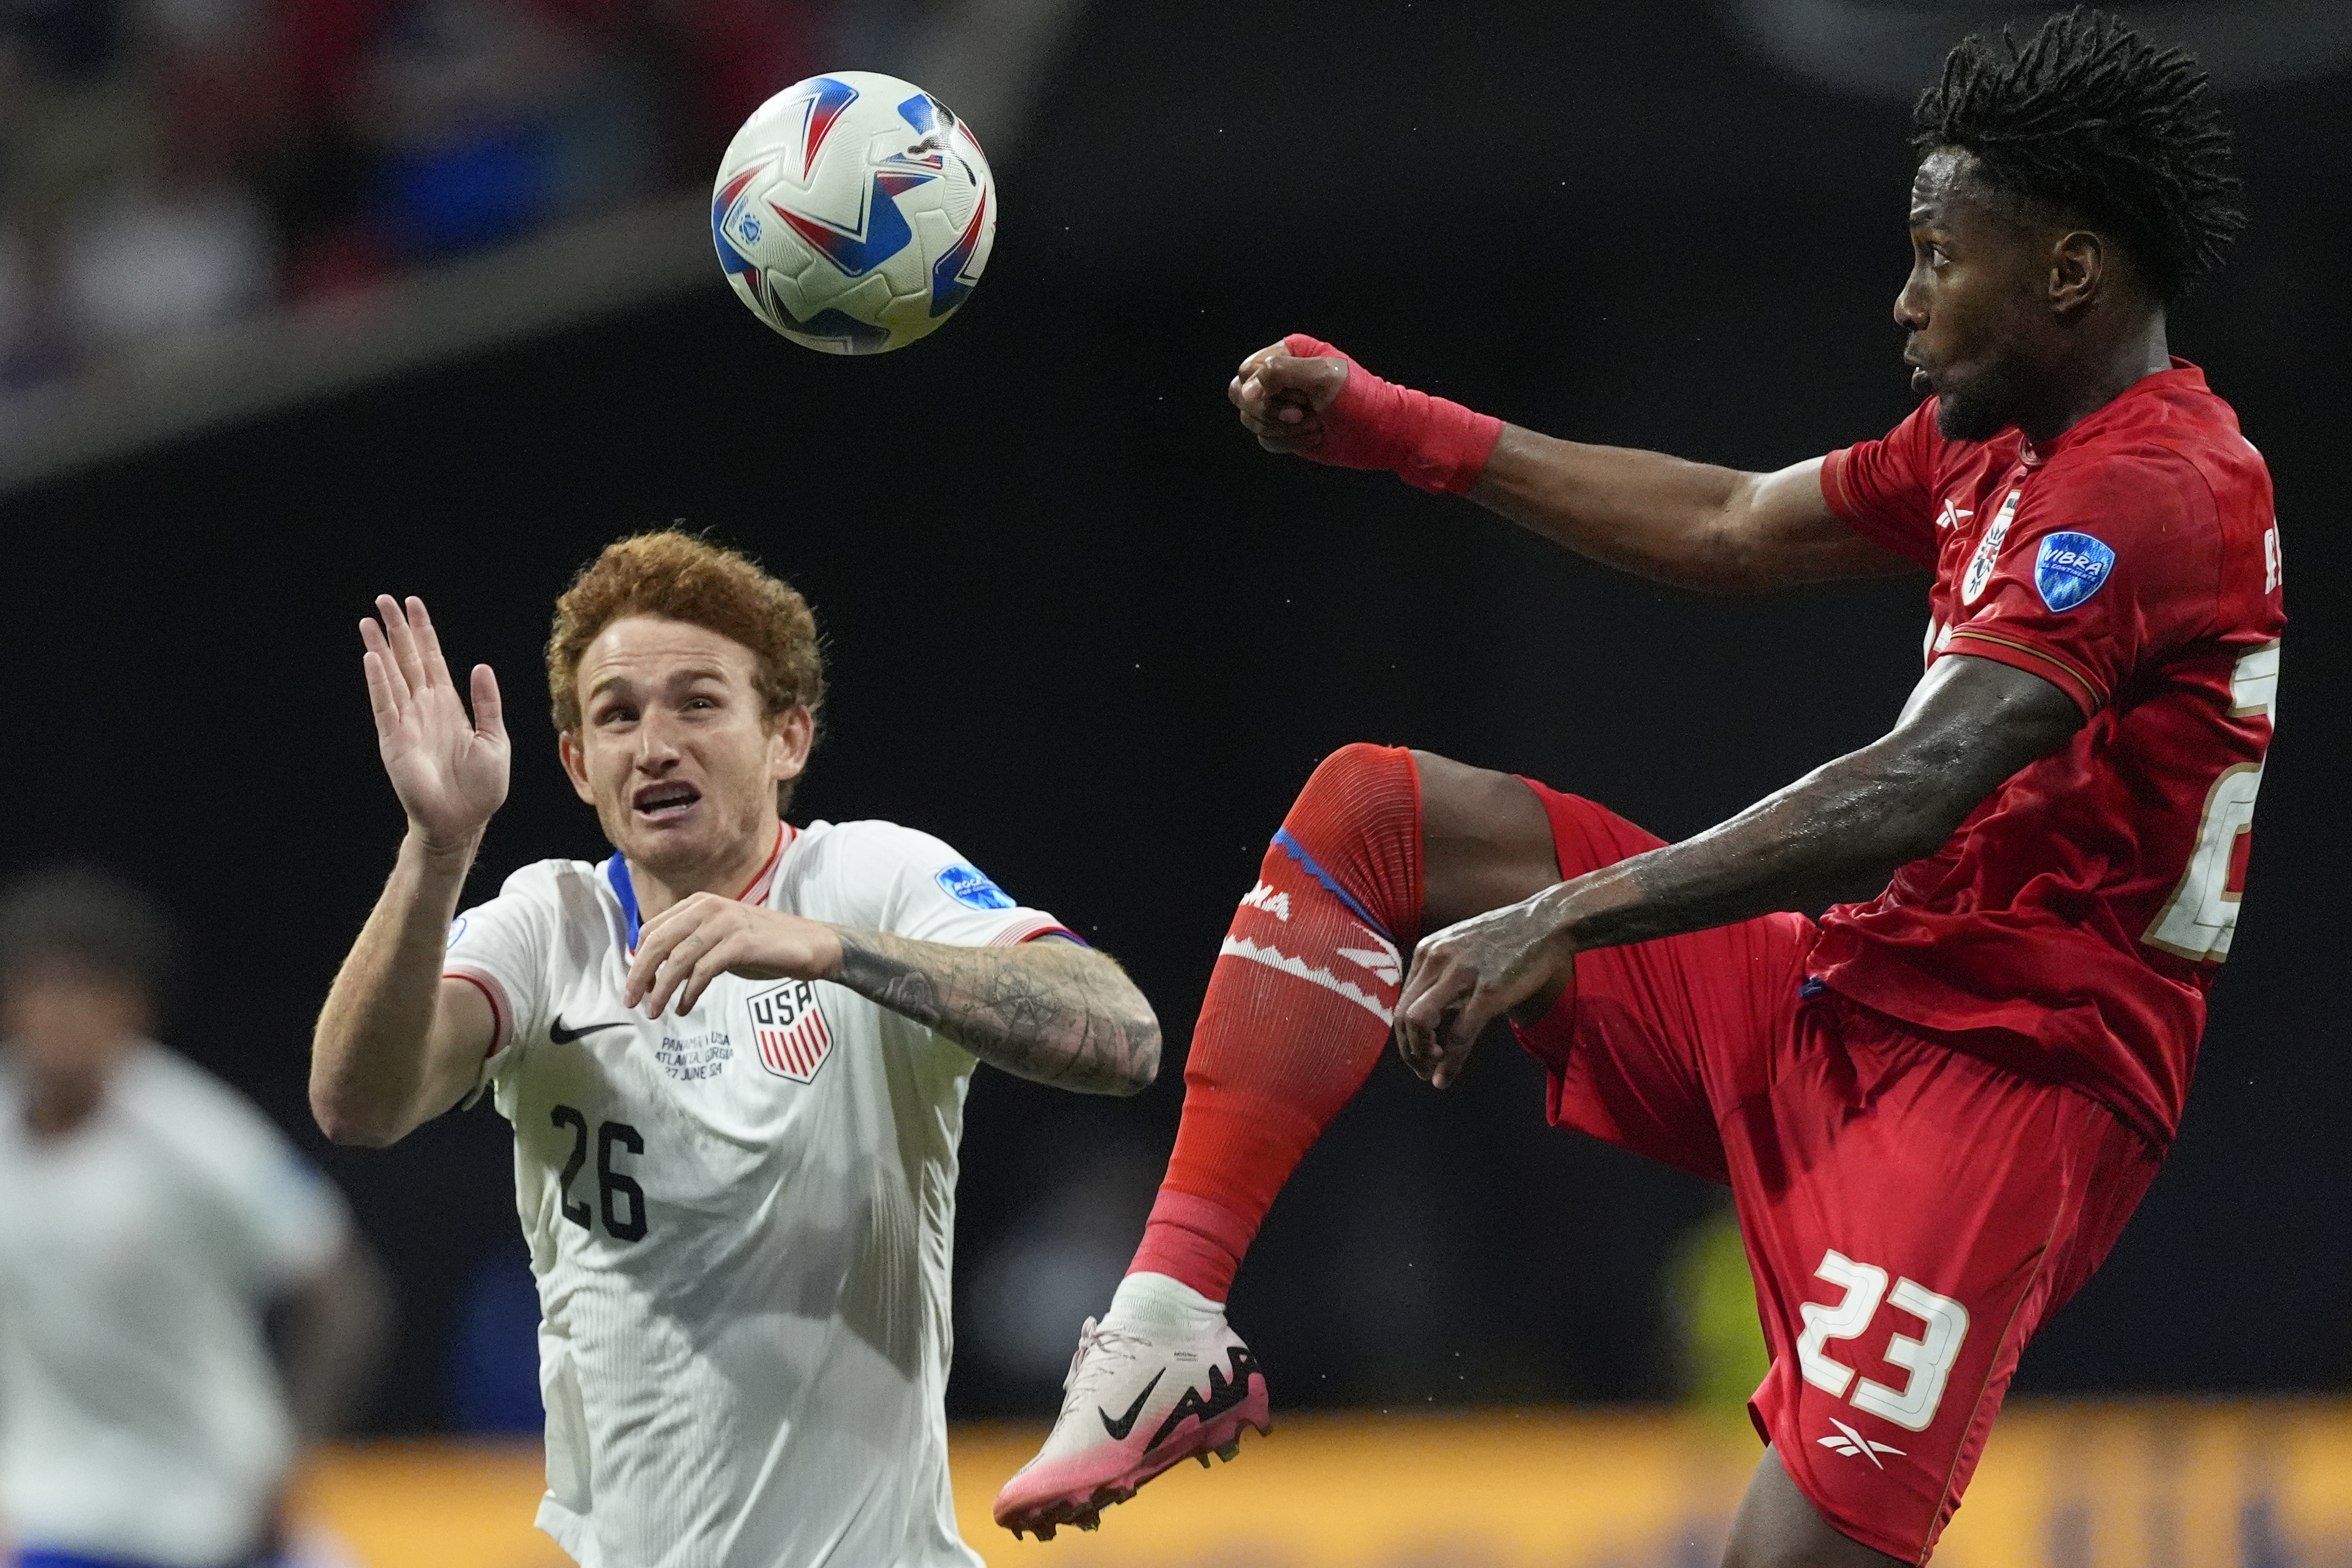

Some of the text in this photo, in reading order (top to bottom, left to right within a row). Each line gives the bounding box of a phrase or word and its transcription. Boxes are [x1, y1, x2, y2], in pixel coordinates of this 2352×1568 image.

[2045, 549, 2103, 576] VIBRA
[2051, 564, 2097, 582] CONTINENTE
[754, 981, 812, 1025] USA
[711, 1031, 730, 1046] USA
[681, 1066, 706, 1080] JUNE
[550, 1104, 647, 1243] 26
[1796, 1249, 1969, 1432] 23
